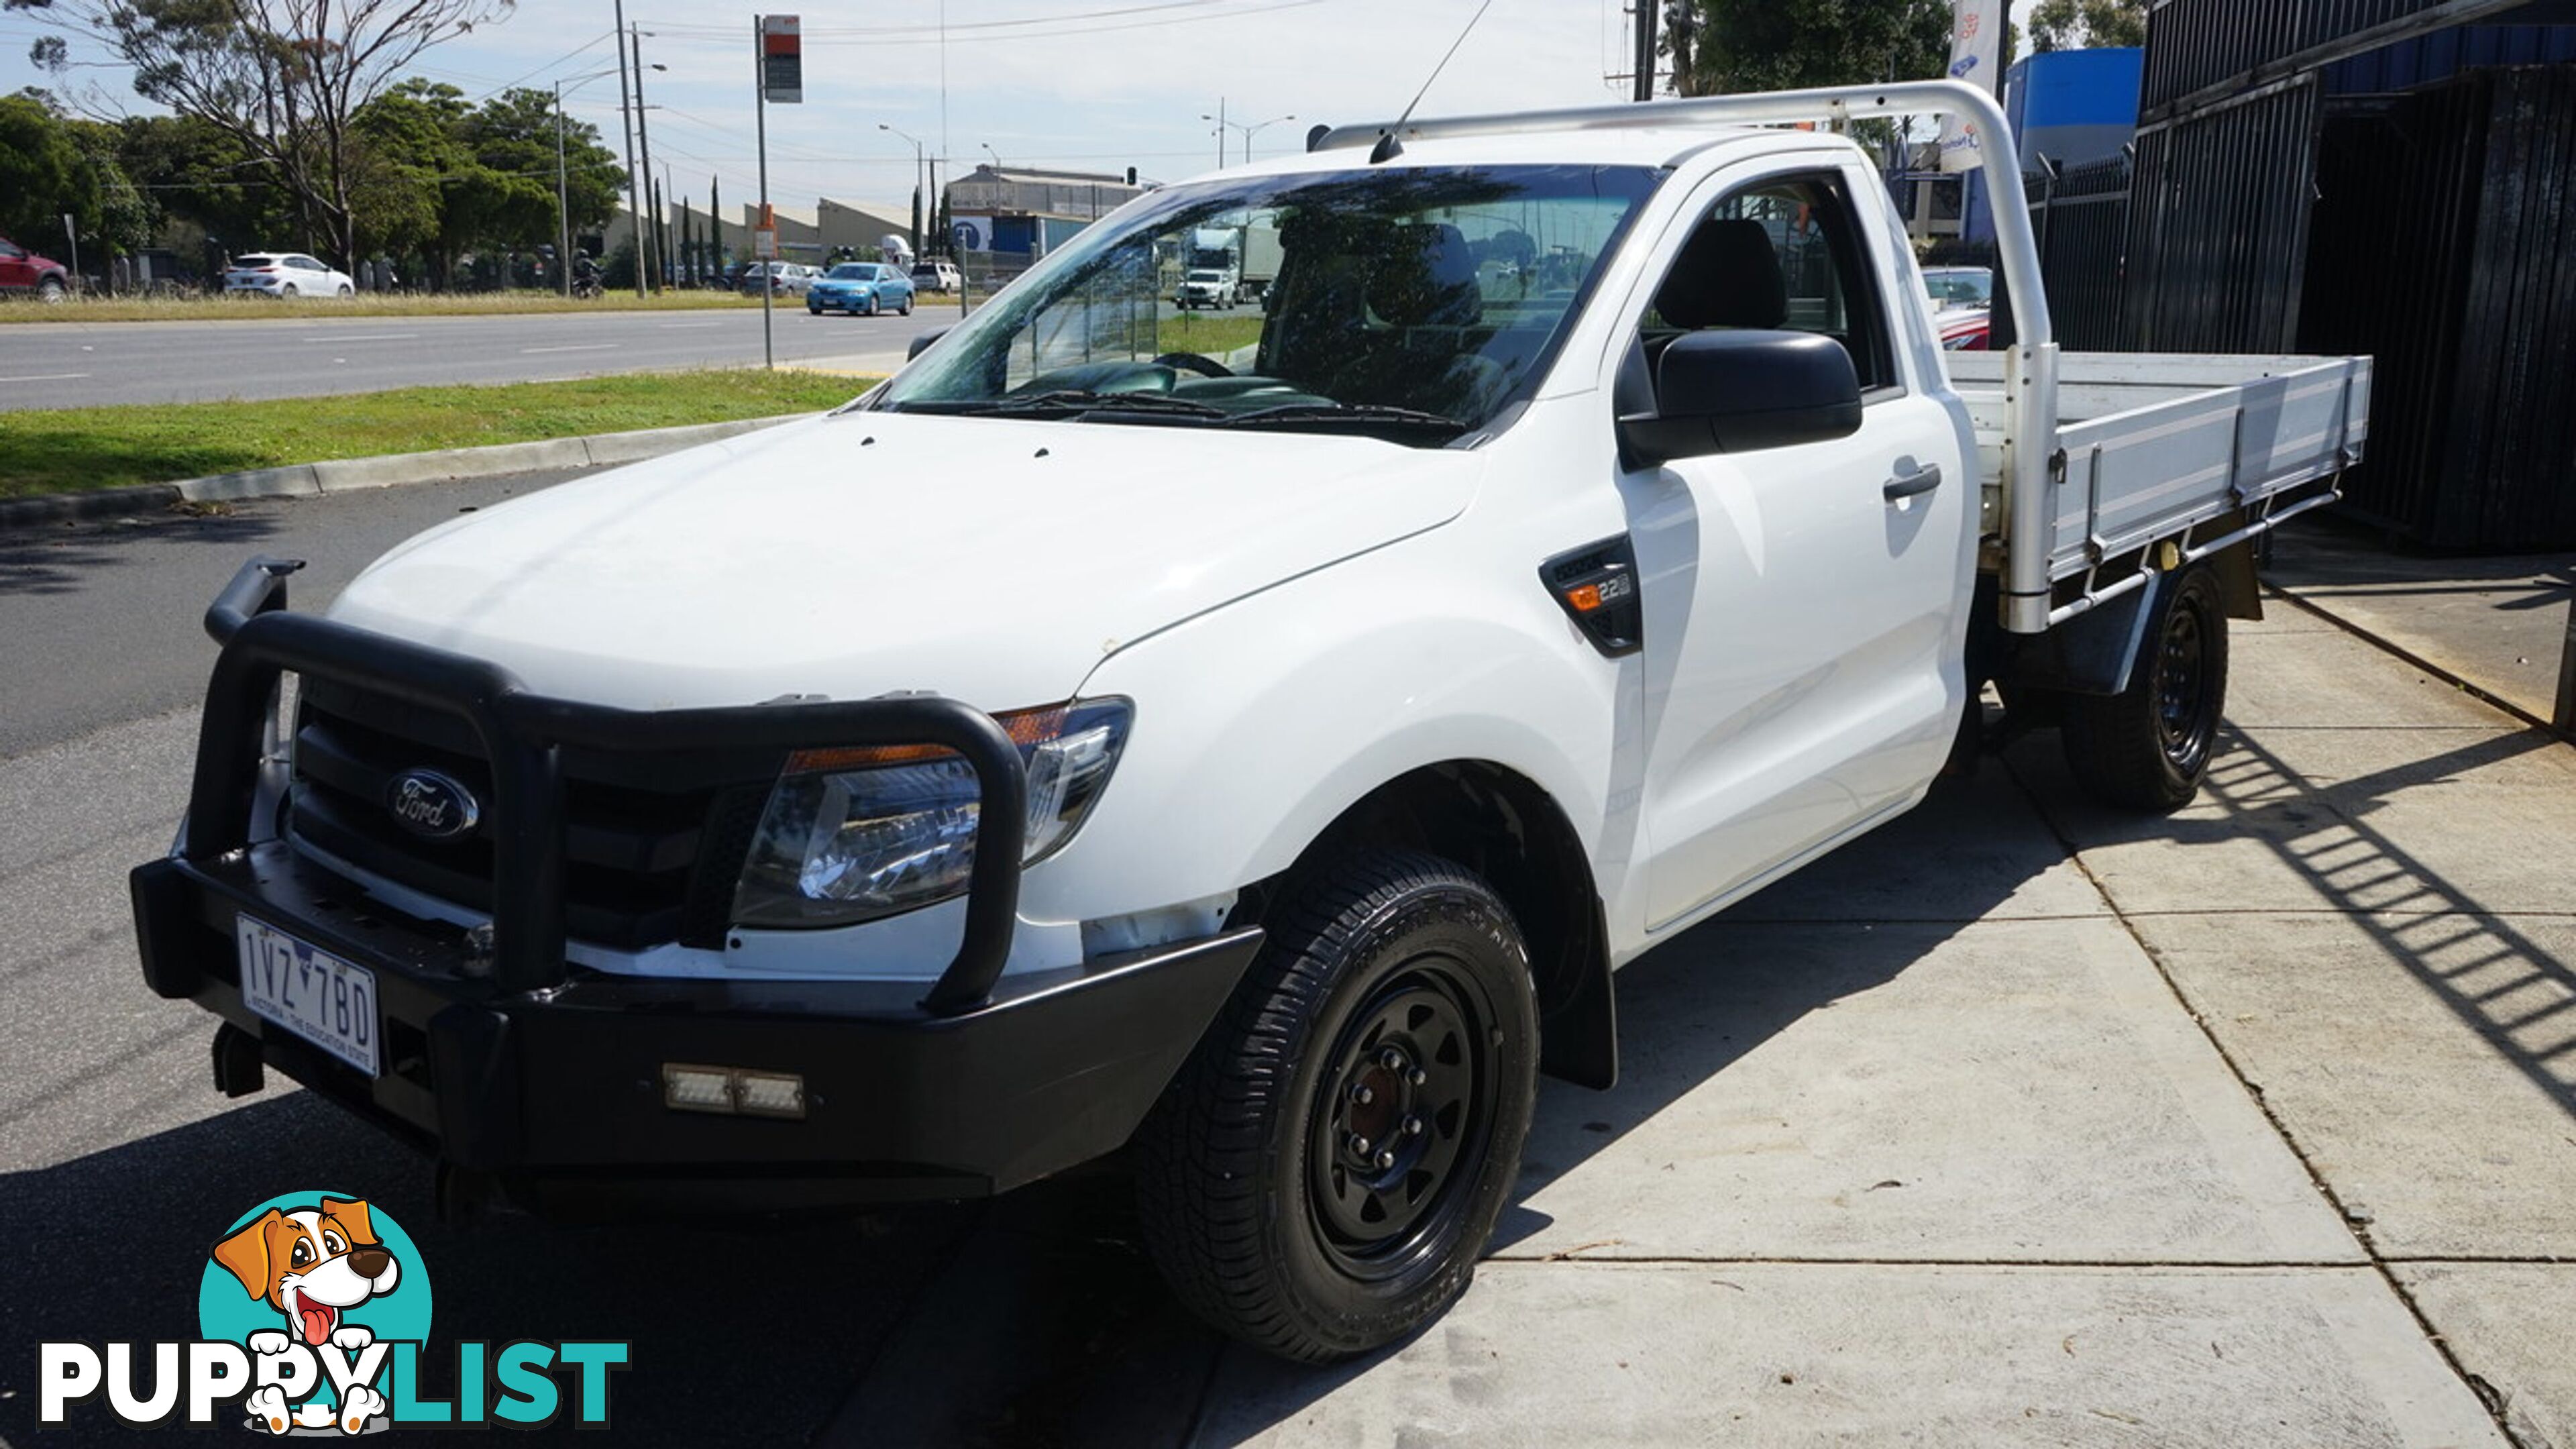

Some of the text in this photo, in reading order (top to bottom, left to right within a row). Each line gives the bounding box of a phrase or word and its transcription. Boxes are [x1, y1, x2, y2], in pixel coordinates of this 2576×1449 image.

[395, 778, 448, 826] Ford
[306, 1022, 346, 1054] EDUCATION
[347, 1044, 369, 1066] STATE
